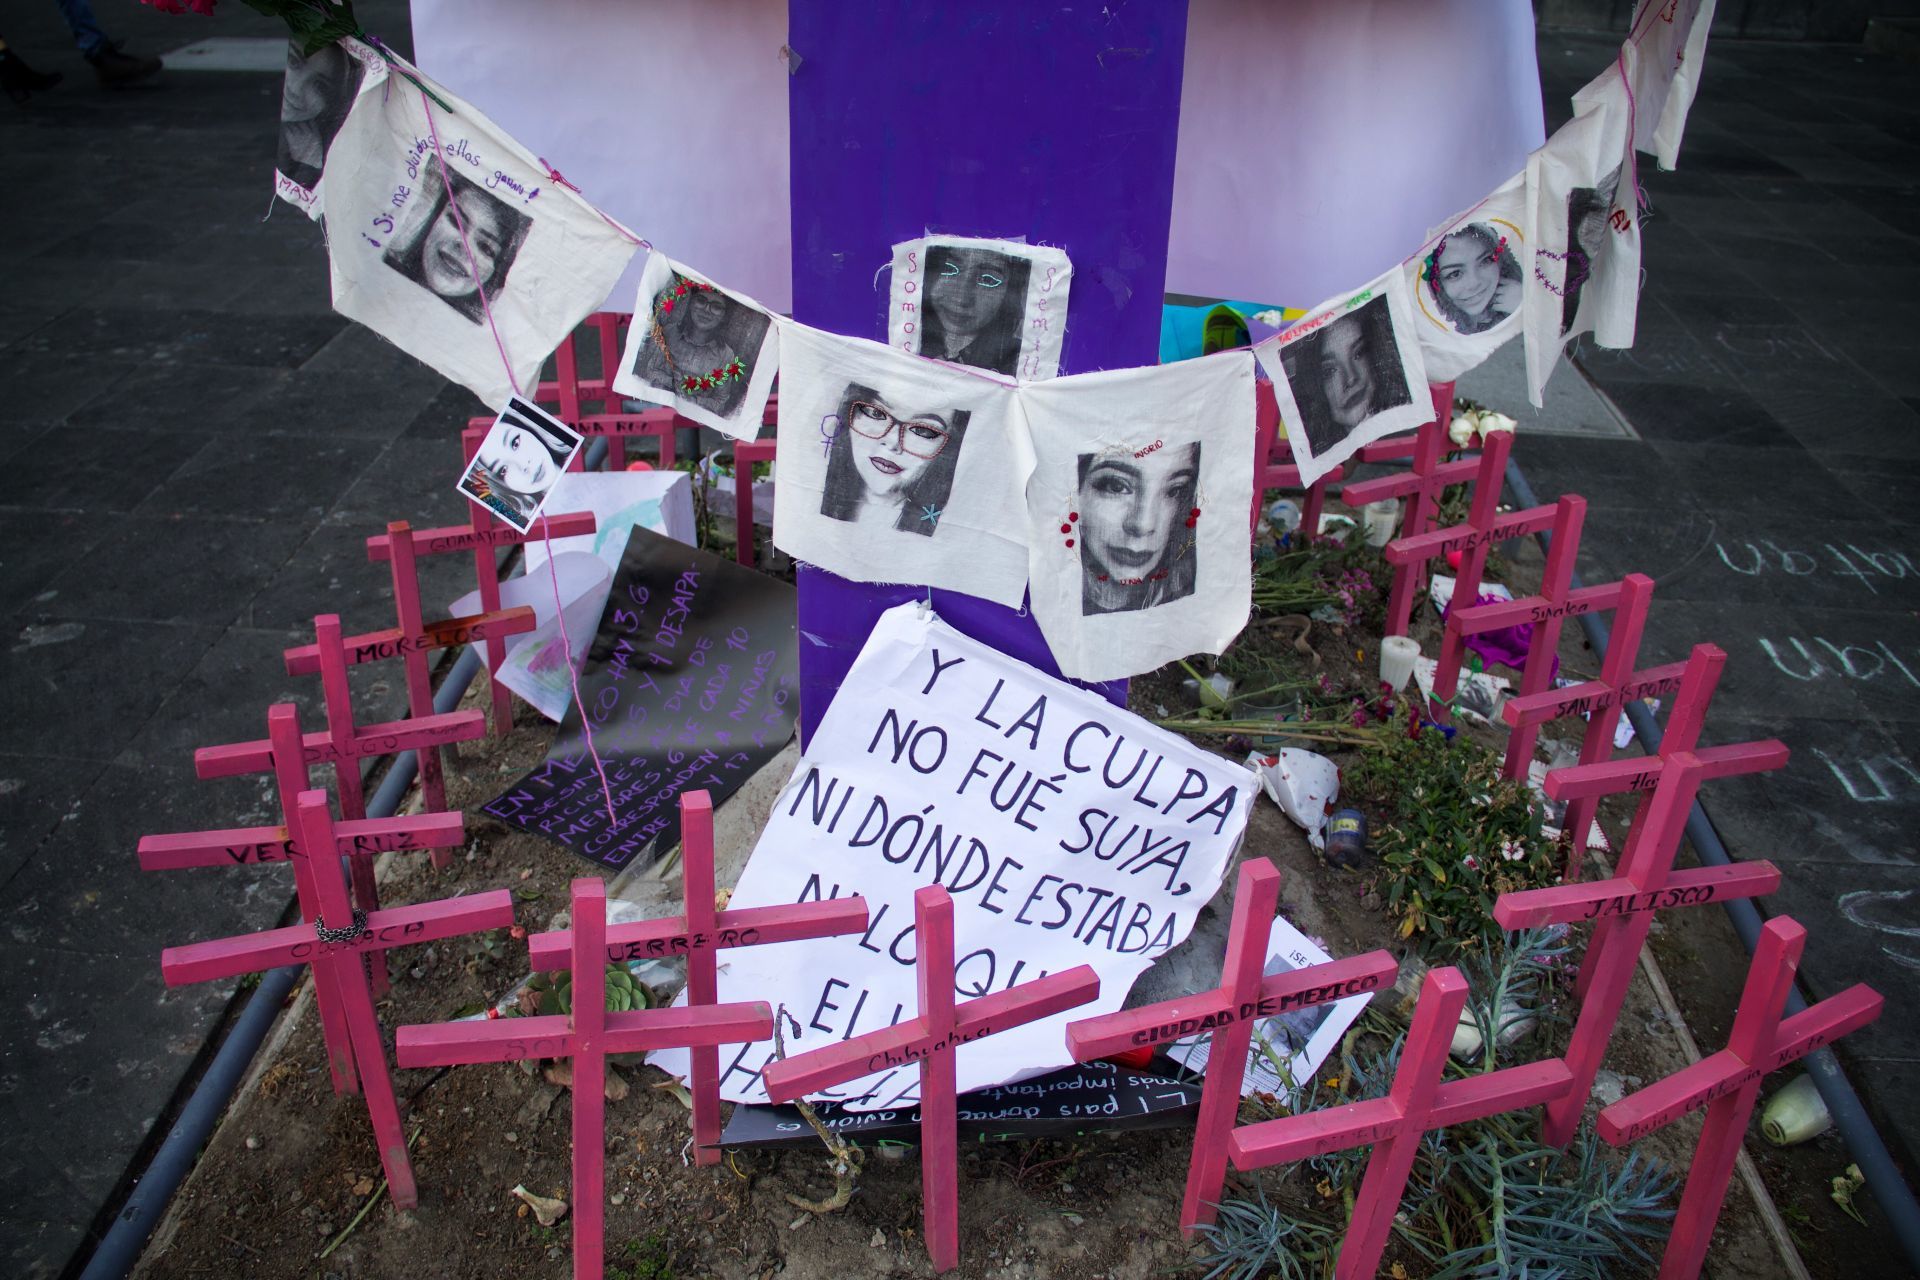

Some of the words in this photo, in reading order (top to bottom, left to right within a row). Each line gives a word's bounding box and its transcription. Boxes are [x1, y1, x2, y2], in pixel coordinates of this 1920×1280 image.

[391, 184, 411, 208] me
[1023, 266, 1057, 376] Semill
[1134, 439, 1163, 458] INGRID
[1441, 522, 1531, 556] DURANGO
[614, 584, 649, 632] 3.6
[354, 624, 488, 664] MORELOS
[607, 638, 635, 680] HAY
[688, 636, 714, 667] DE
[638, 671, 662, 695] Y
[667, 749, 685, 765] 6
[699, 663, 732, 712] CADA
[725, 626, 749, 651] 10
[1554, 696, 1591, 718] SAN
[1637, 677, 1683, 701] POTOS
[921, 648, 965, 695] Y
[975, 678, 1048, 751] LA
[1062, 720, 1239, 835] CULPA
[484, 788, 534, 818] EN
[583, 748, 720, 854] CORRESPONDEN
[867, 708, 949, 775] NO
[956, 747, 1068, 831] FUÉ
[1059, 807, 1194, 897] SUYA,
[603, 816, 672, 864] ENTRE
[788, 767, 855, 834] NI
[847, 795, 1024, 915] DÓNDE
[1015, 873, 1177, 955] ESTABA
[1584, 884, 1715, 920] JALISCO
[606, 926, 761, 963] UERRERO
[1131, 1010, 1235, 1046] CIUDAD
[1240, 997, 1277, 1021] DE
[1280, 974, 1379, 1011] MEXICO
[775, 1122, 801, 1132] es
[1628, 1113, 1668, 1141] Baja
